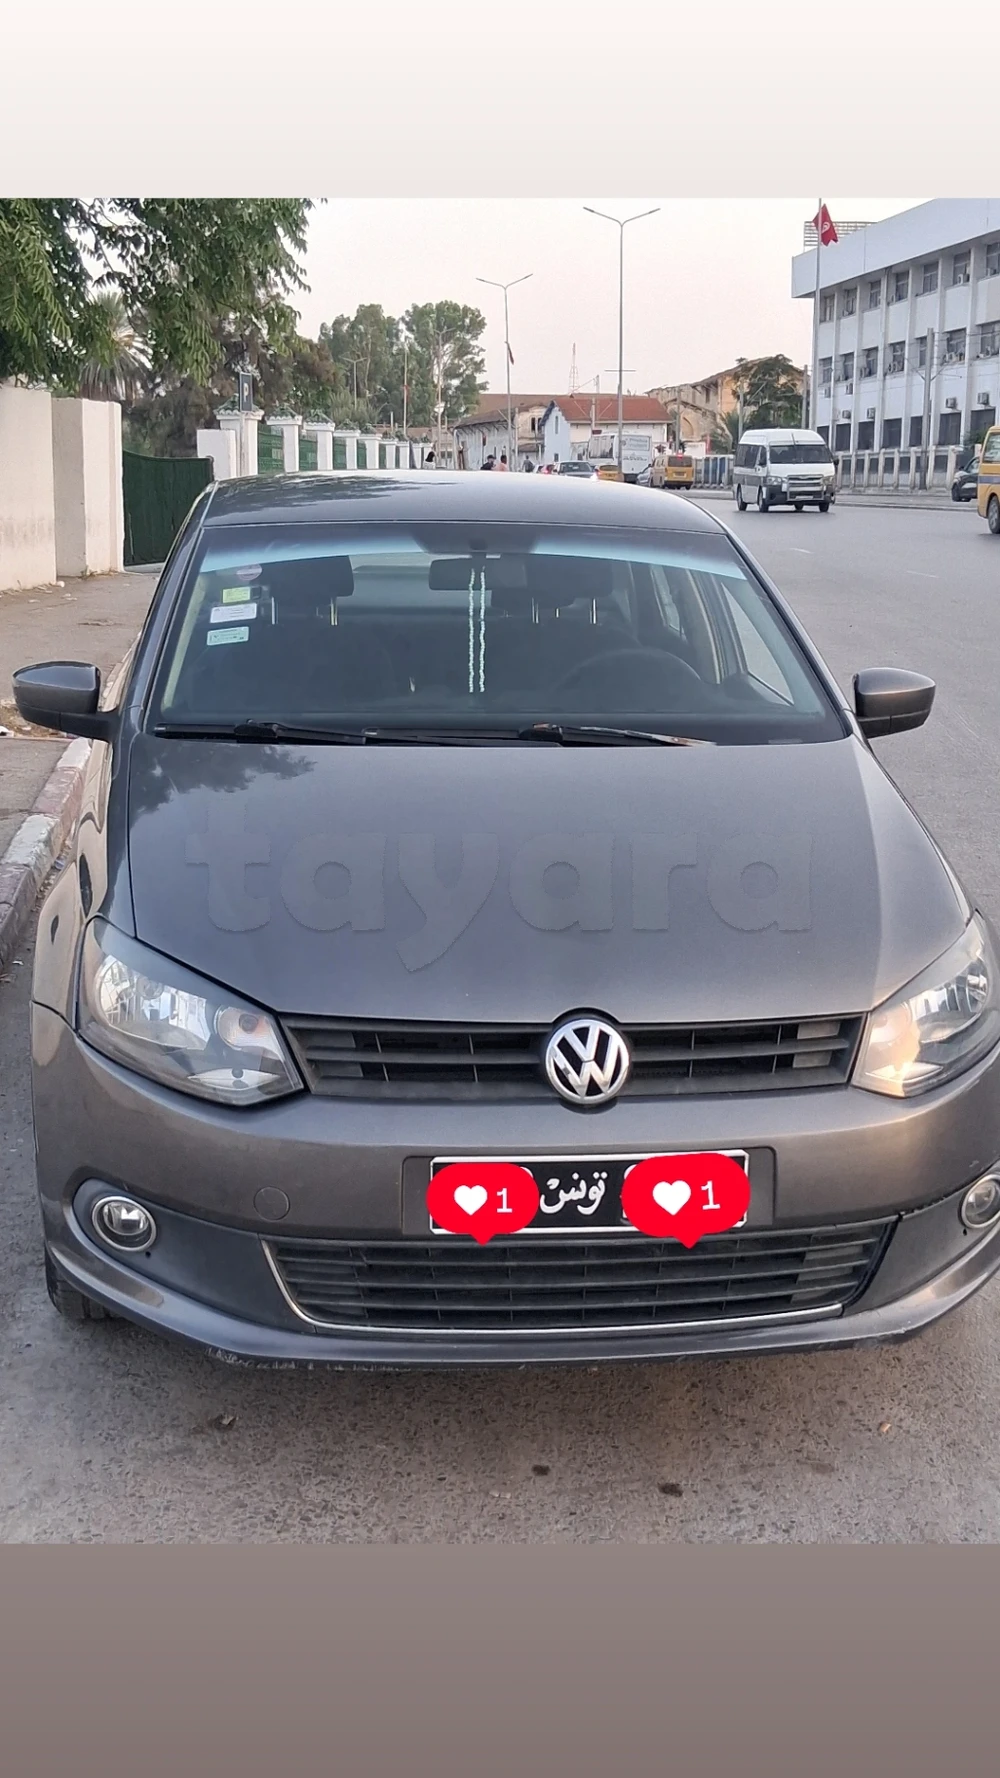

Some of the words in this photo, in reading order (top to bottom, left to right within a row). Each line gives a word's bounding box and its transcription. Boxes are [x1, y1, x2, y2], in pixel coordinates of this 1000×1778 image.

[243, 382, 250, 402] P
[546, 1019, 630, 1104] VW
[540, 1171, 608, 1215] تونس
